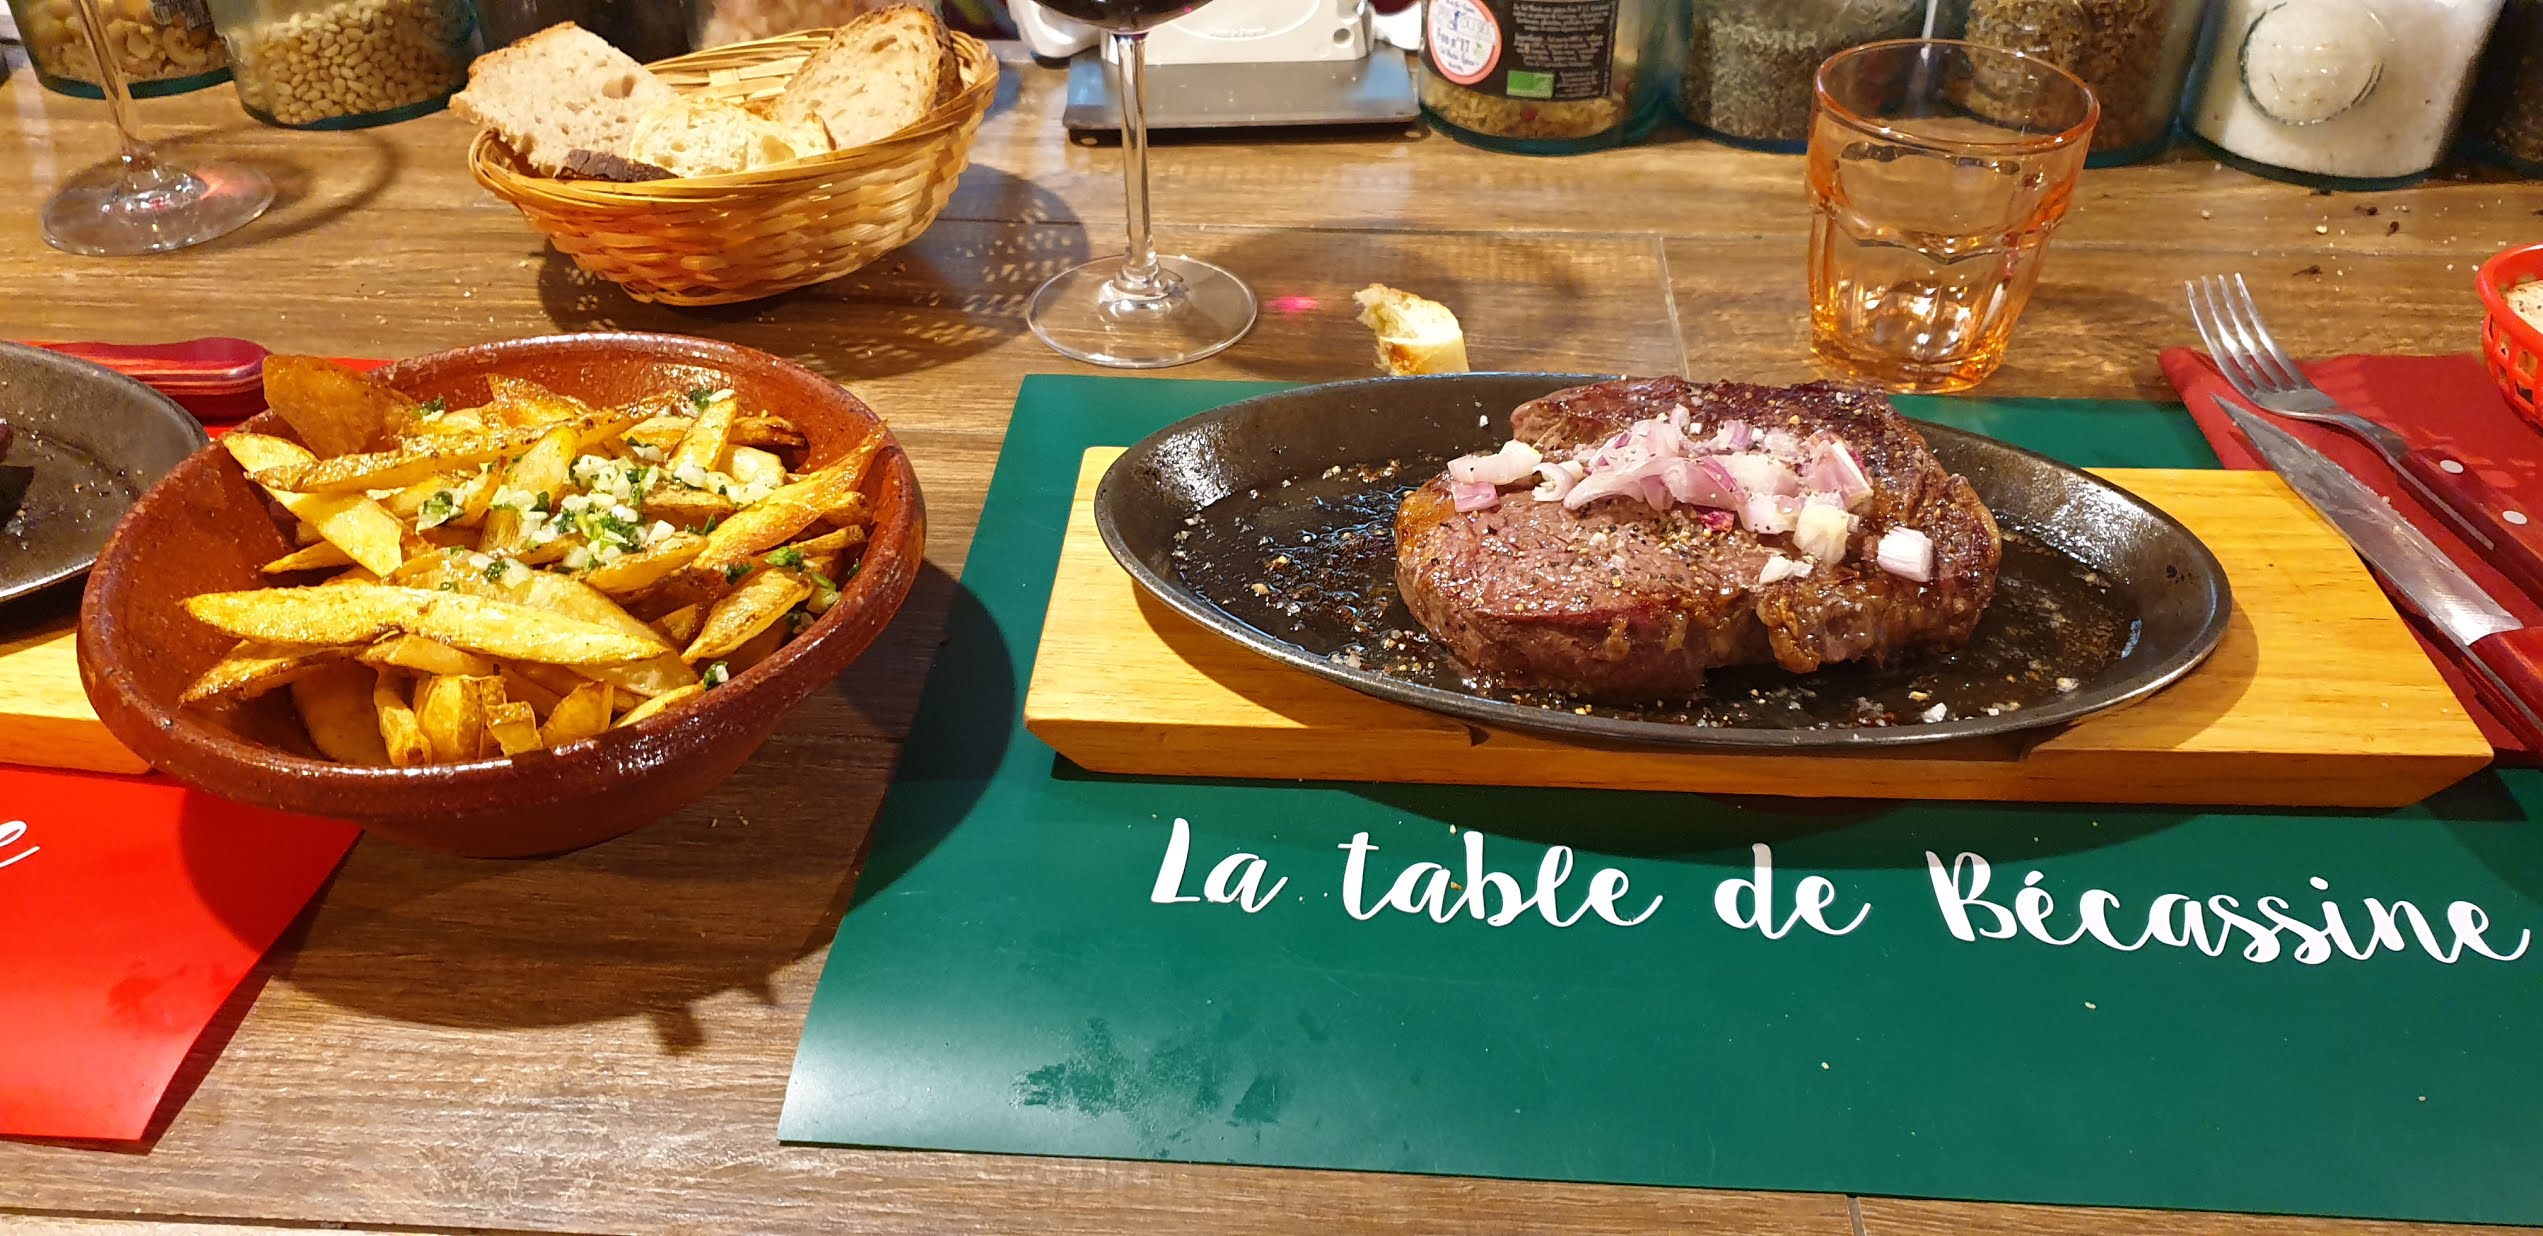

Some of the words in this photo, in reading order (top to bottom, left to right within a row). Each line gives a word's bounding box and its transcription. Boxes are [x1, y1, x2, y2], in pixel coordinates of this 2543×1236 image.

[1150, 817, 1289, 914] La
[1337, 830, 1664, 928] table
[1713, 842, 1872, 940] de
[1925, 850, 2531, 965] Bécassine
